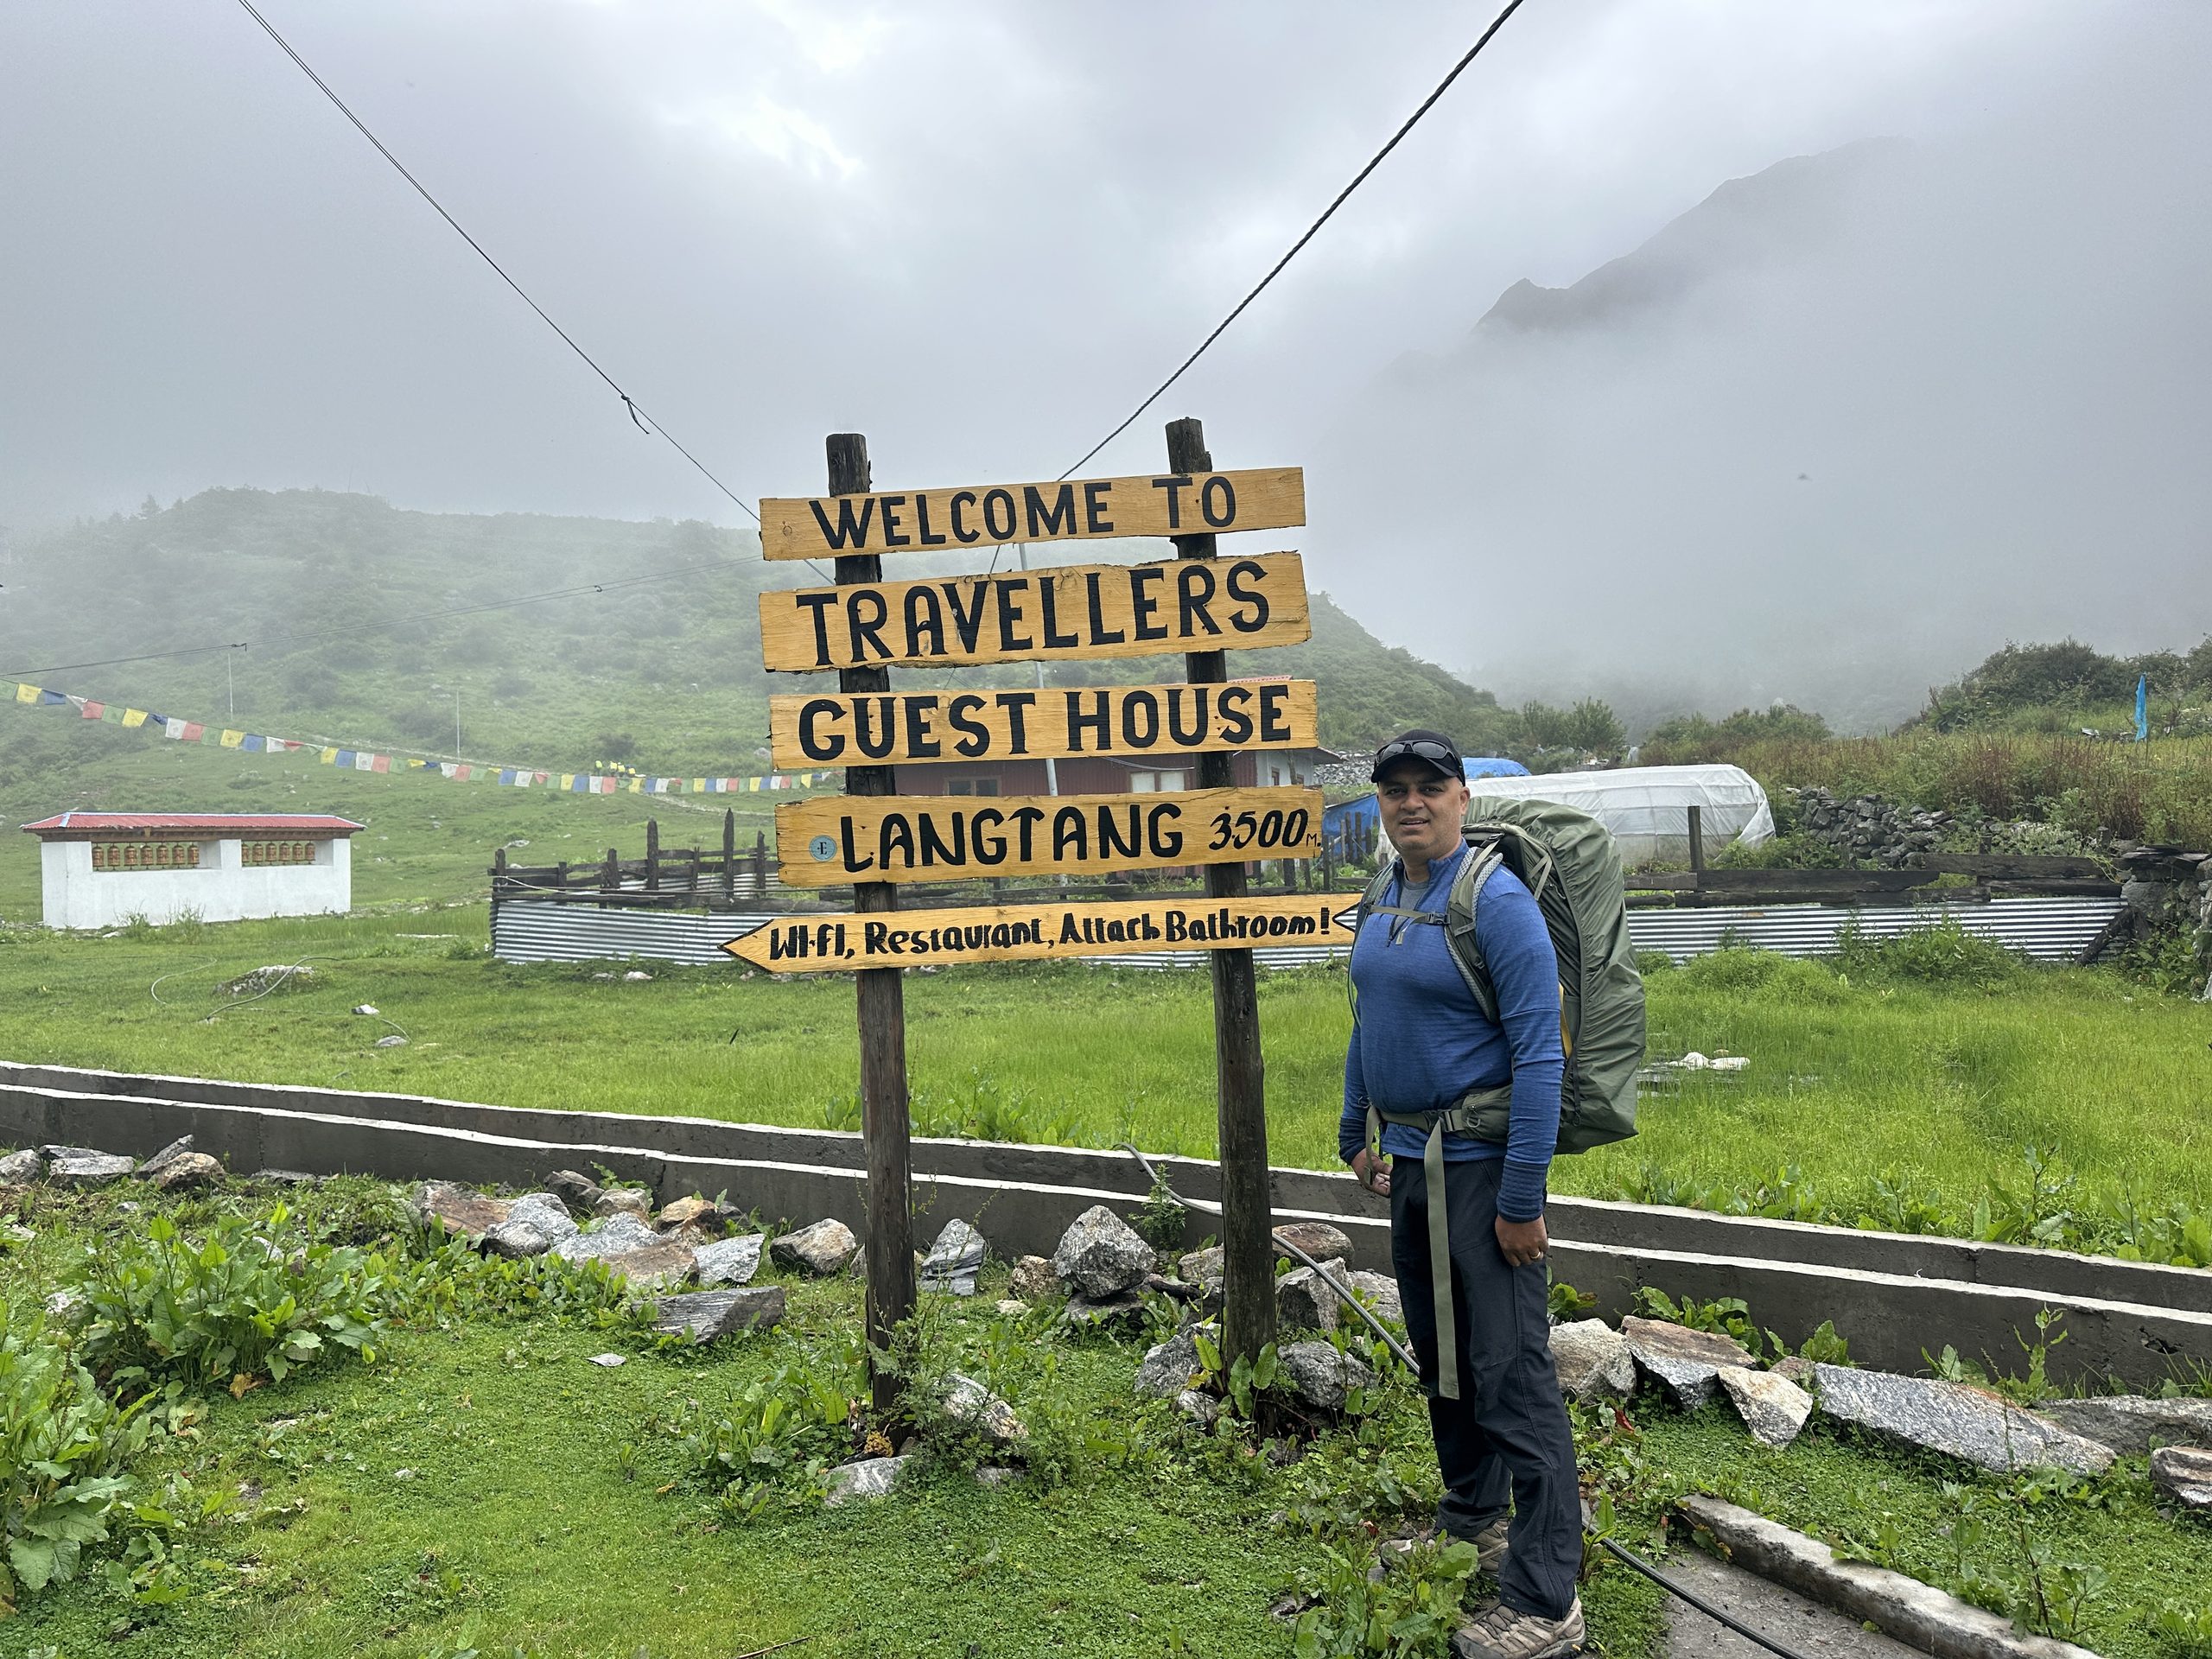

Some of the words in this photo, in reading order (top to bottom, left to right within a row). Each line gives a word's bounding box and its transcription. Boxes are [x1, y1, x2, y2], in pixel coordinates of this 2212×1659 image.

[808, 481, 1114, 550] WELCOME
[1152, 476, 1236, 529] TO
[795, 560, 1270, 666] TRAVELLERS
[798, 691, 1037, 761] GUEST
[1063, 684, 1292, 752] HOUSE
[840, 803, 1184, 874] LANGTANG
[864, 918, 1055, 955] Restaurant,
[1058, 912, 1160, 944] Attach
[1166, 906, 1331, 943] Bathroom!
